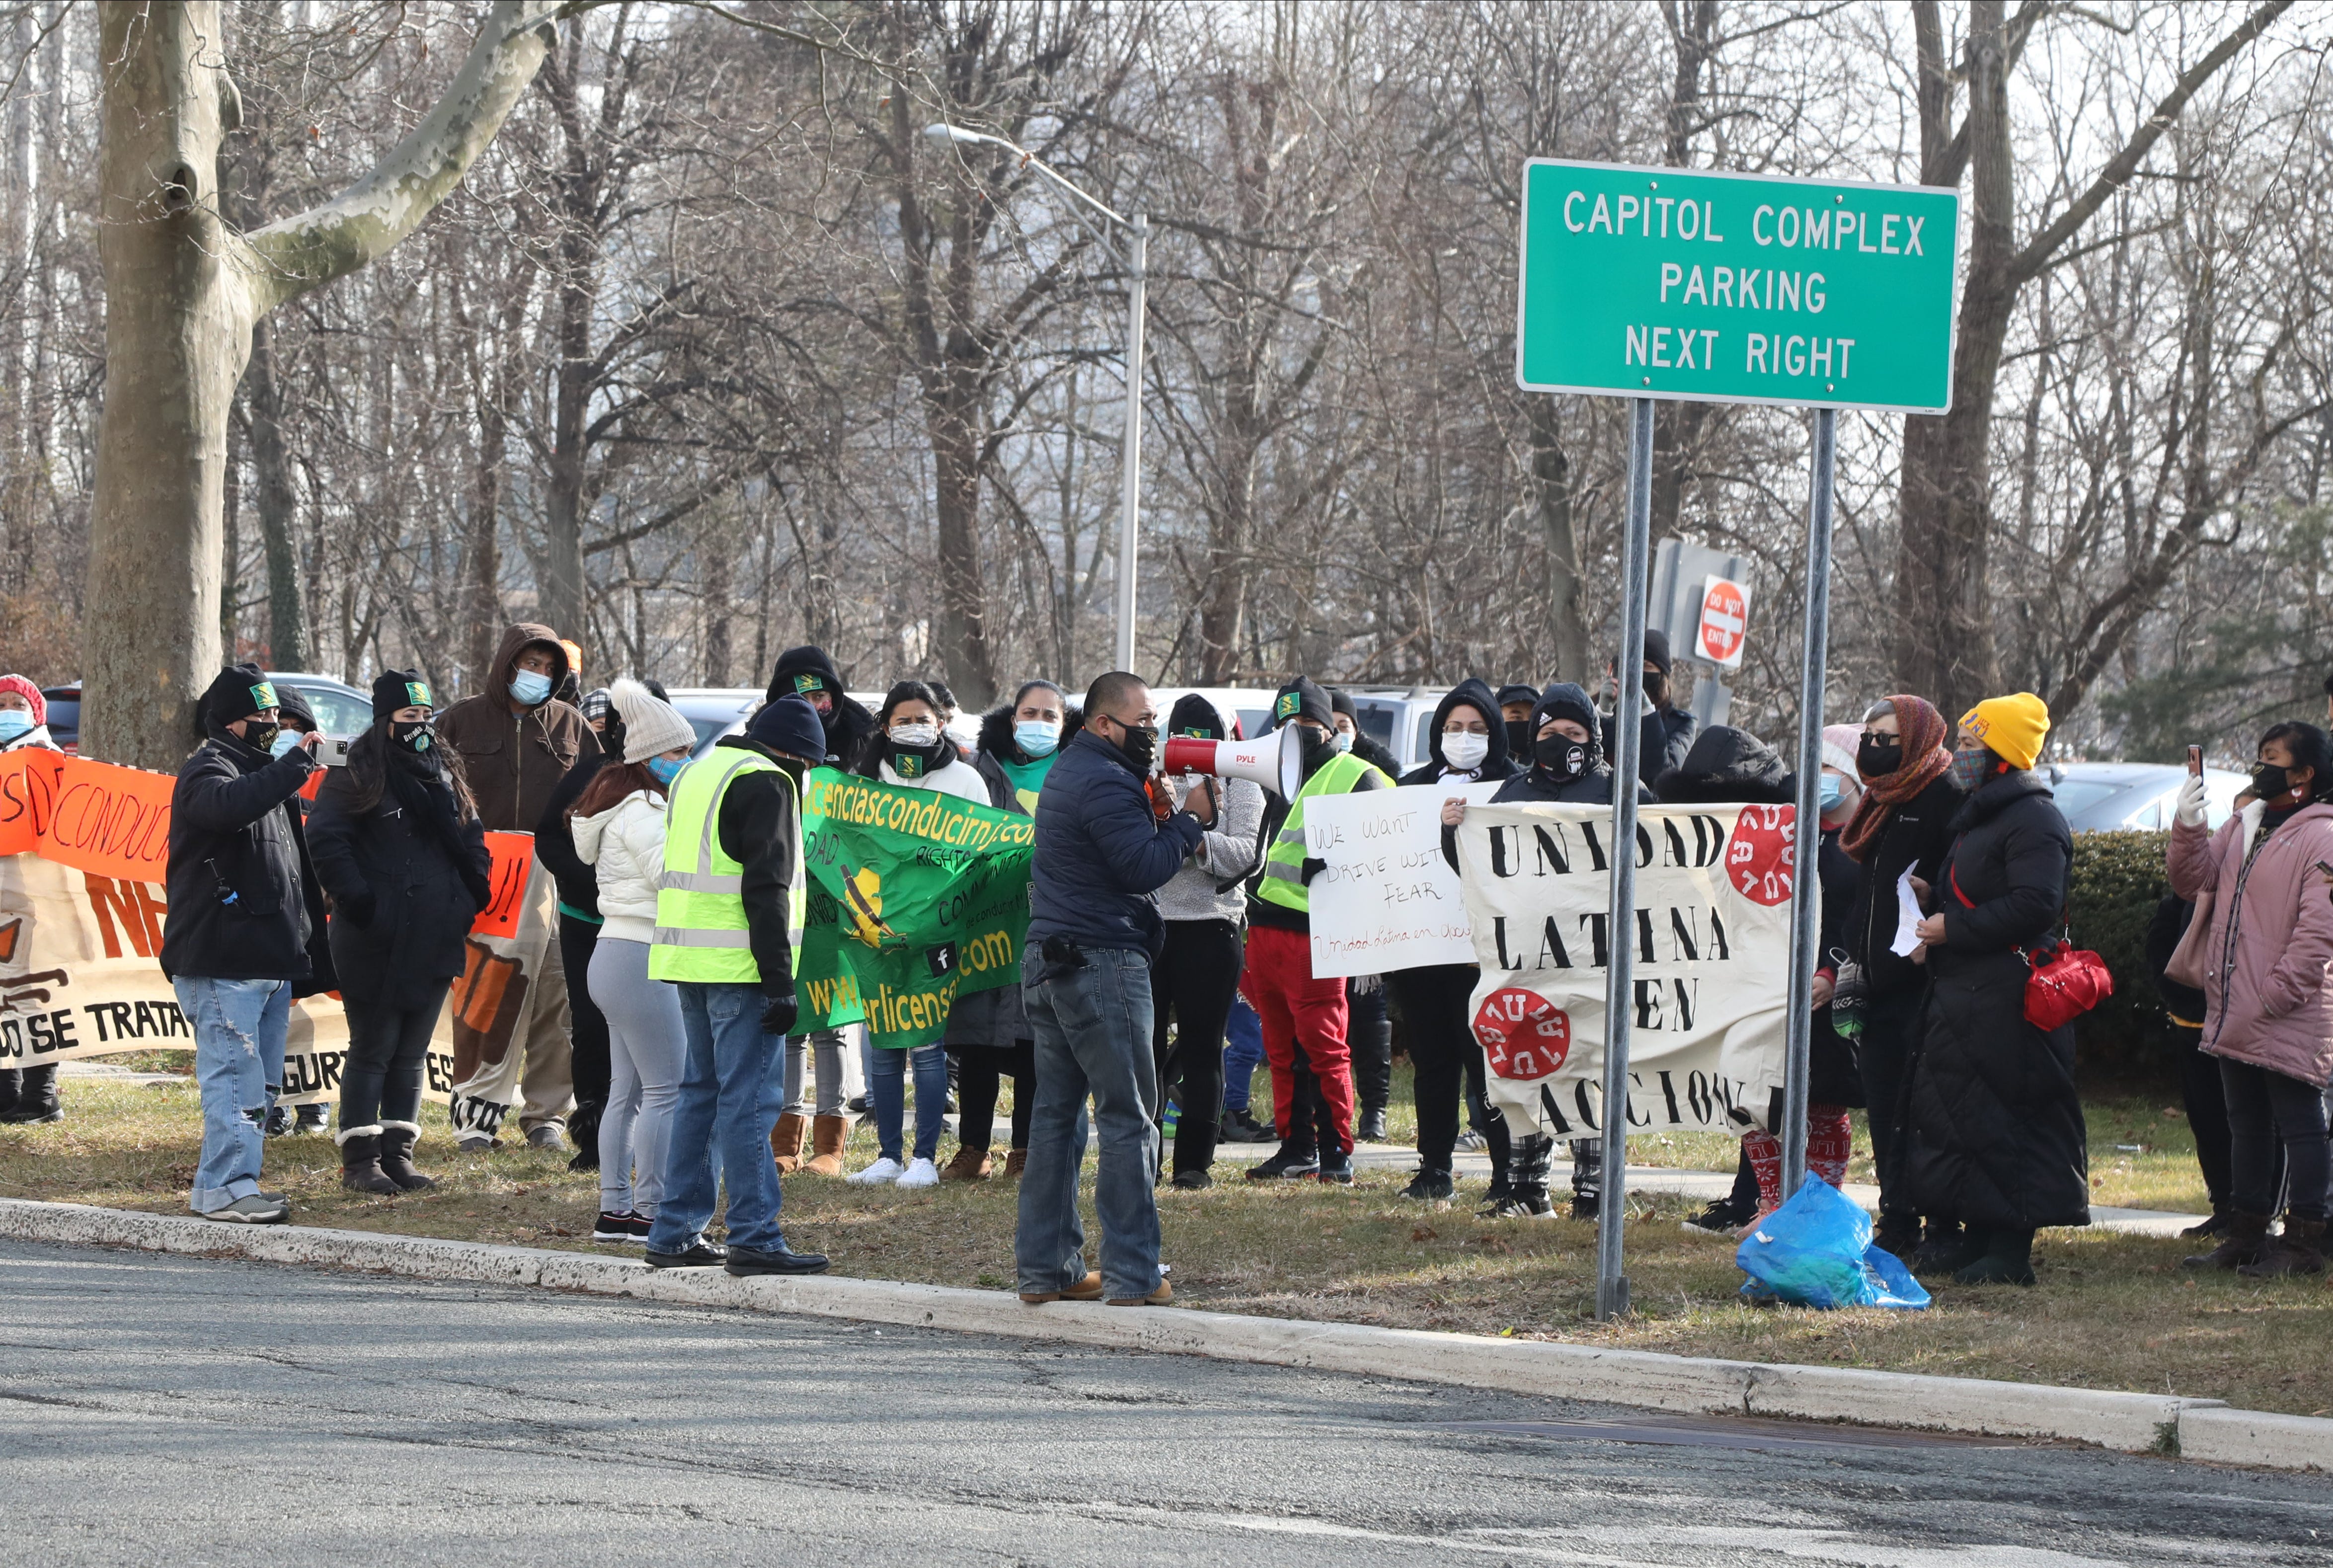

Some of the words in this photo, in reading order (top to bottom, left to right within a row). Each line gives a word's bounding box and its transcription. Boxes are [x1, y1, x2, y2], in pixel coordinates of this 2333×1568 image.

[1563, 190, 1723, 242] CAPITOL
[1753, 204, 1926, 256] COMPLEX
[1660, 262, 1826, 314] PARKING
[1626, 324, 1719, 371] NEXT
[1746, 332, 1856, 379] RIGHT
[1710, 593, 1722, 608] DO
[1725, 598, 1742, 613] NOT
[403, 725, 423, 742] Brenda
[1236, 755, 1256, 763] PYLE
[1311, 823, 1345, 849] WE
[1486, 815, 1725, 878] UNIDAD
[1325, 857, 1387, 883] DRIVE
[1492, 906, 1730, 970] LATINA
[27, 1008, 79, 1054] SE
[83, 1001, 190, 1042] TRATA
[1632, 977, 1700, 1032] EN
